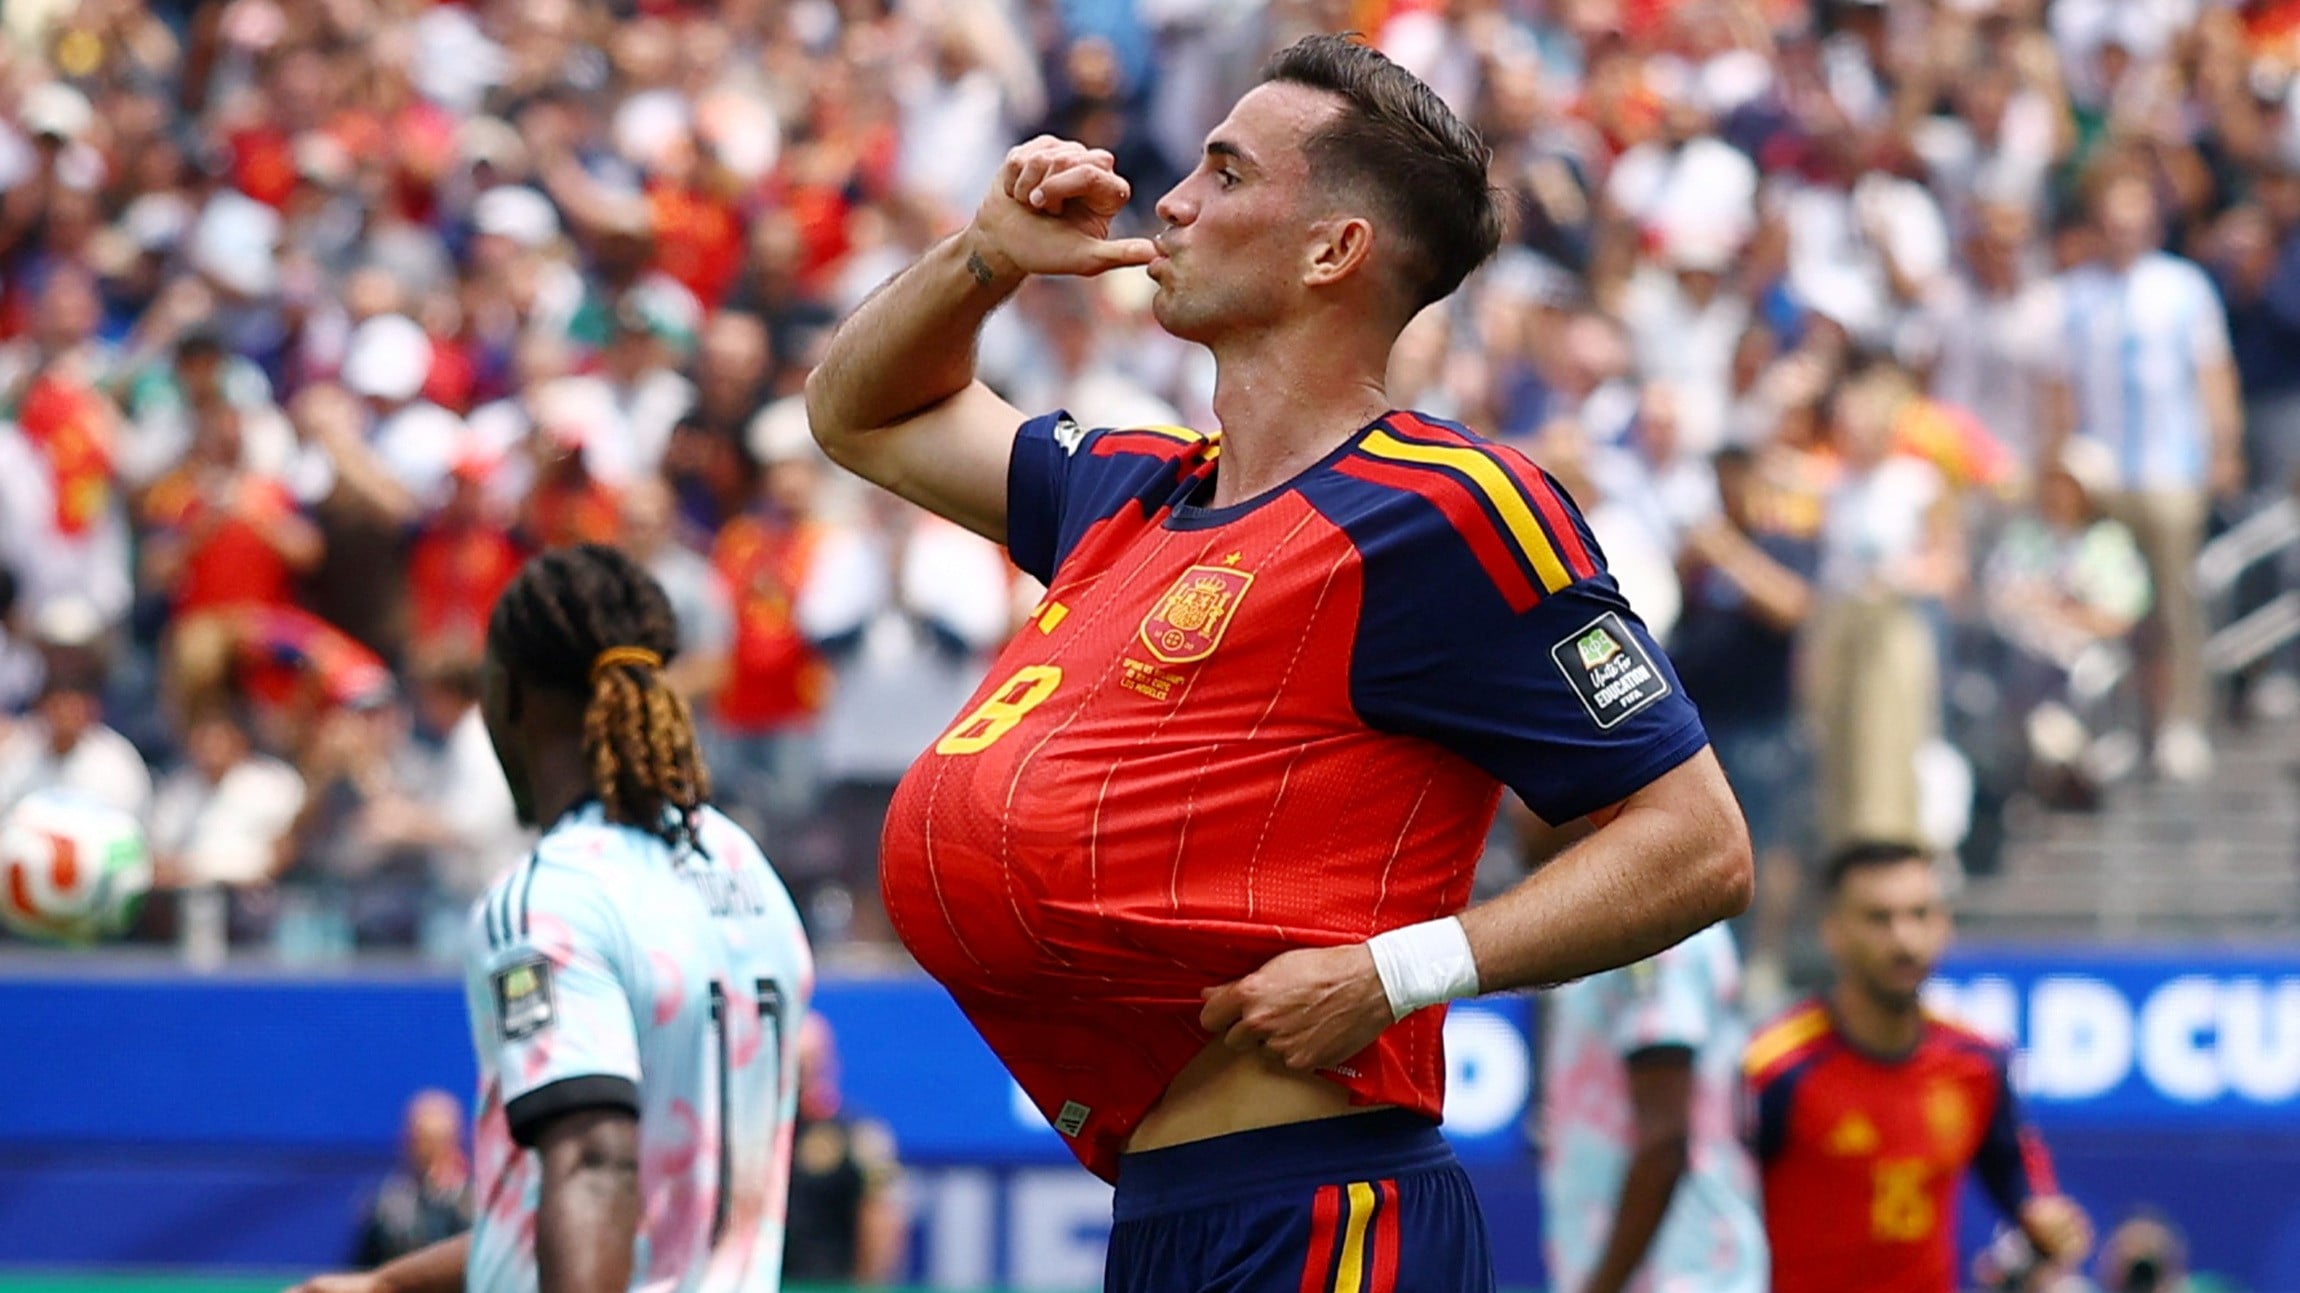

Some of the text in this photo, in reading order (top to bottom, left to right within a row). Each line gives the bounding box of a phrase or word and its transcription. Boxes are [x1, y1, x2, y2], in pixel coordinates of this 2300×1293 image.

[1593, 664, 1652, 709] EDUCATION
[1619, 688, 1644, 708] FIFA
[935, 665, 1063, 755] 8
